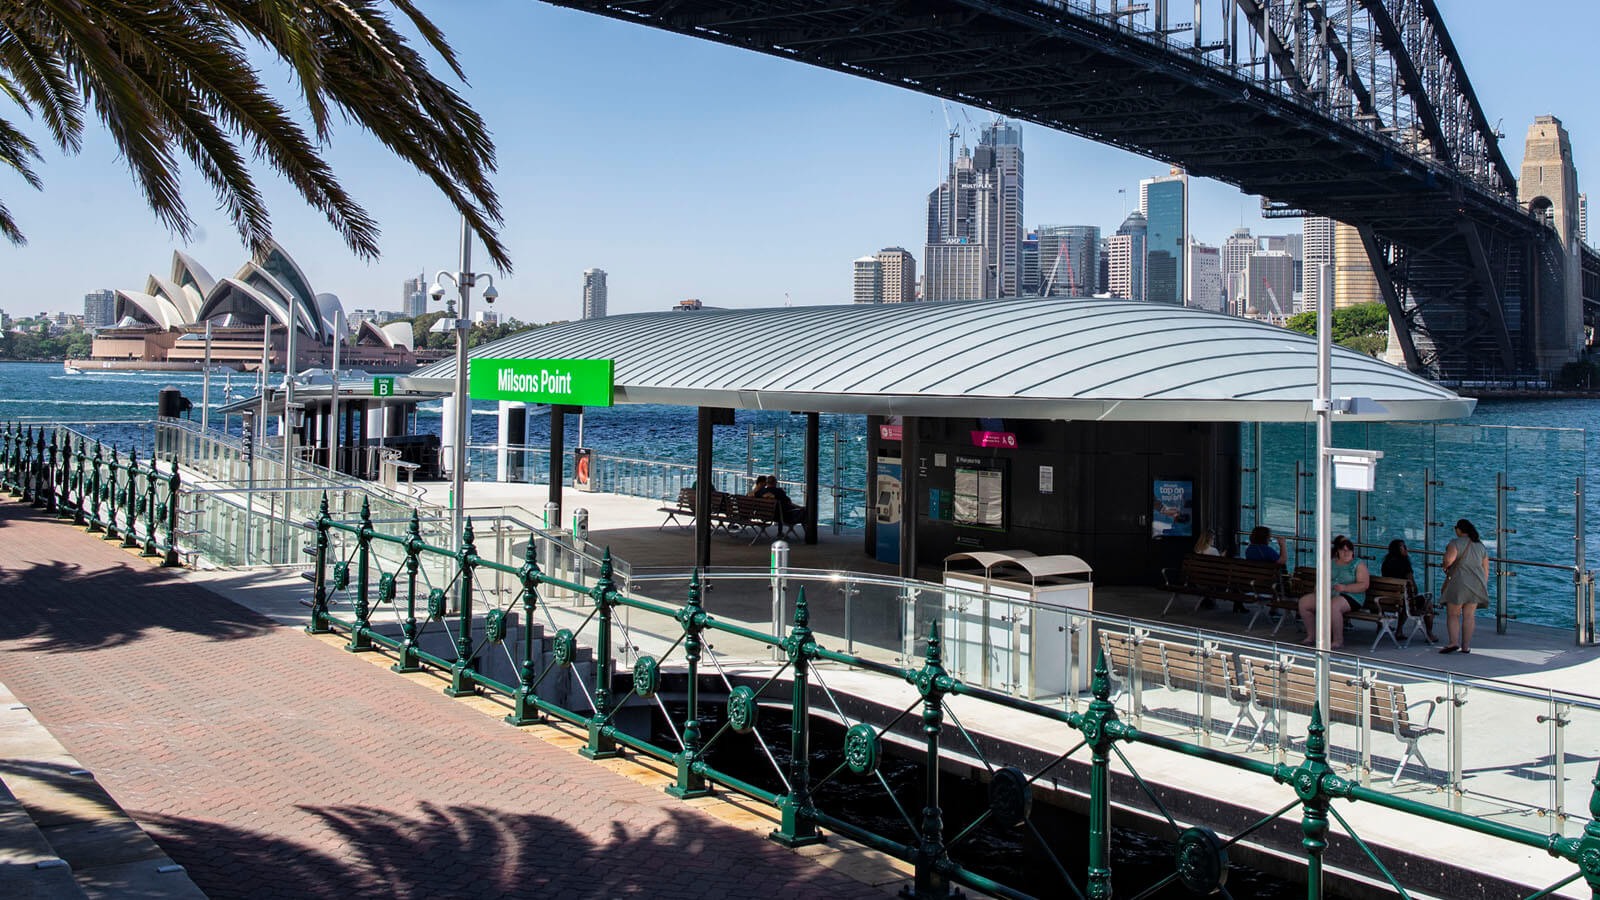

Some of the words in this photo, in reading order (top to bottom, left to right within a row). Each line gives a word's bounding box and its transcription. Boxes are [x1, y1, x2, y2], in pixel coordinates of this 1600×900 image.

[498, 368, 539, 393] Milsons
[540, 369, 571, 394] Point
[380, 383, 388, 395] B
[1160, 486, 1173, 495] tap
